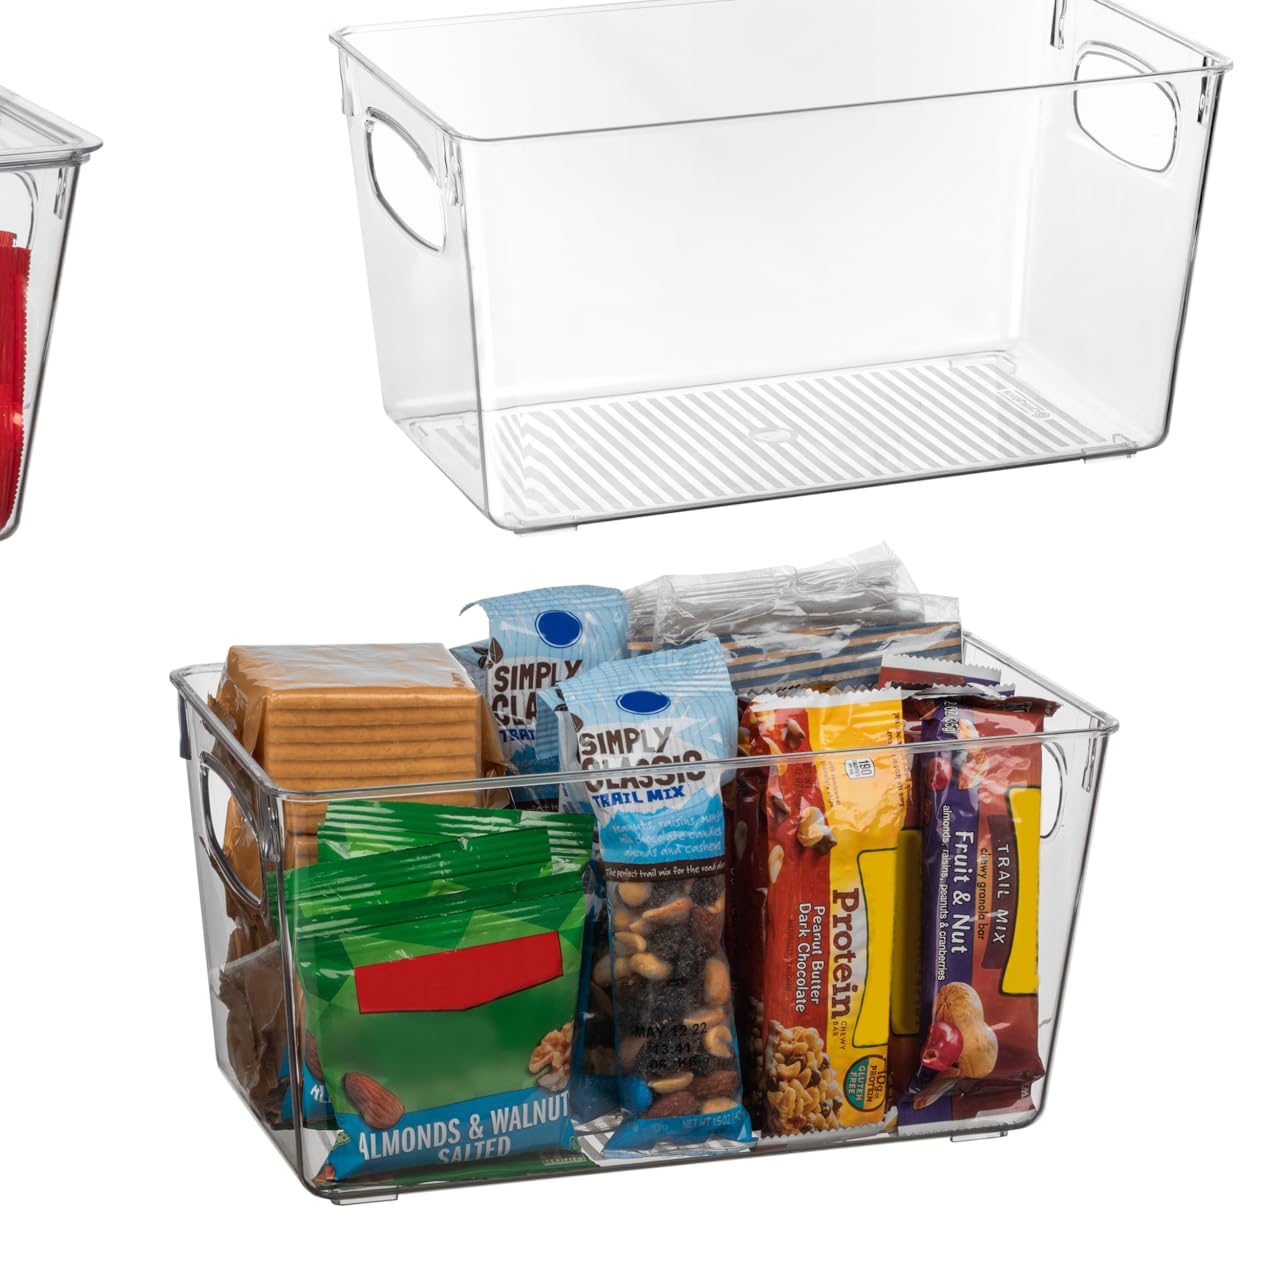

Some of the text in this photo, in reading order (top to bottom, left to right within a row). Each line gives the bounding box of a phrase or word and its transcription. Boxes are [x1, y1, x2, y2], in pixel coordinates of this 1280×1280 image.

[493, 659, 583, 693] SIMPLY
[580, 726, 673, 756] SIMPLY
[580, 750, 707, 793] CLASSIC
[861, 759, 872, 776] 190
[591, 785, 686, 808] TRAIL MIX
[660, 845, 681, 856] and
[616, 863, 700, 879] perfect trail mix for the
[936, 805, 952, 981] almonds, raisins, peanuts & cranberries
[950, 830, 975, 954] Fruit & Nut
[976, 847, 993, 941] chewy granola bar
[992, 843, 1011, 945] TRAIL MIX
[795, 902, 812, 1013] Dark Chocolate
[810, 905, 826, 1005] Peanut Butter
[831, 887, 860, 1020] Protein
[692, 1022, 708, 1035] 22
[839, 1020, 848, 1050] CHEWY
[847, 1070, 857, 1095] FREE
[855, 1065, 866, 1102] GLUTEN
[868, 1065, 878, 1103] PROTEIN
[358, 1090, 569, 1161] ALMONDS & WALNUT
[437, 1136, 511, 1165] SALTED
